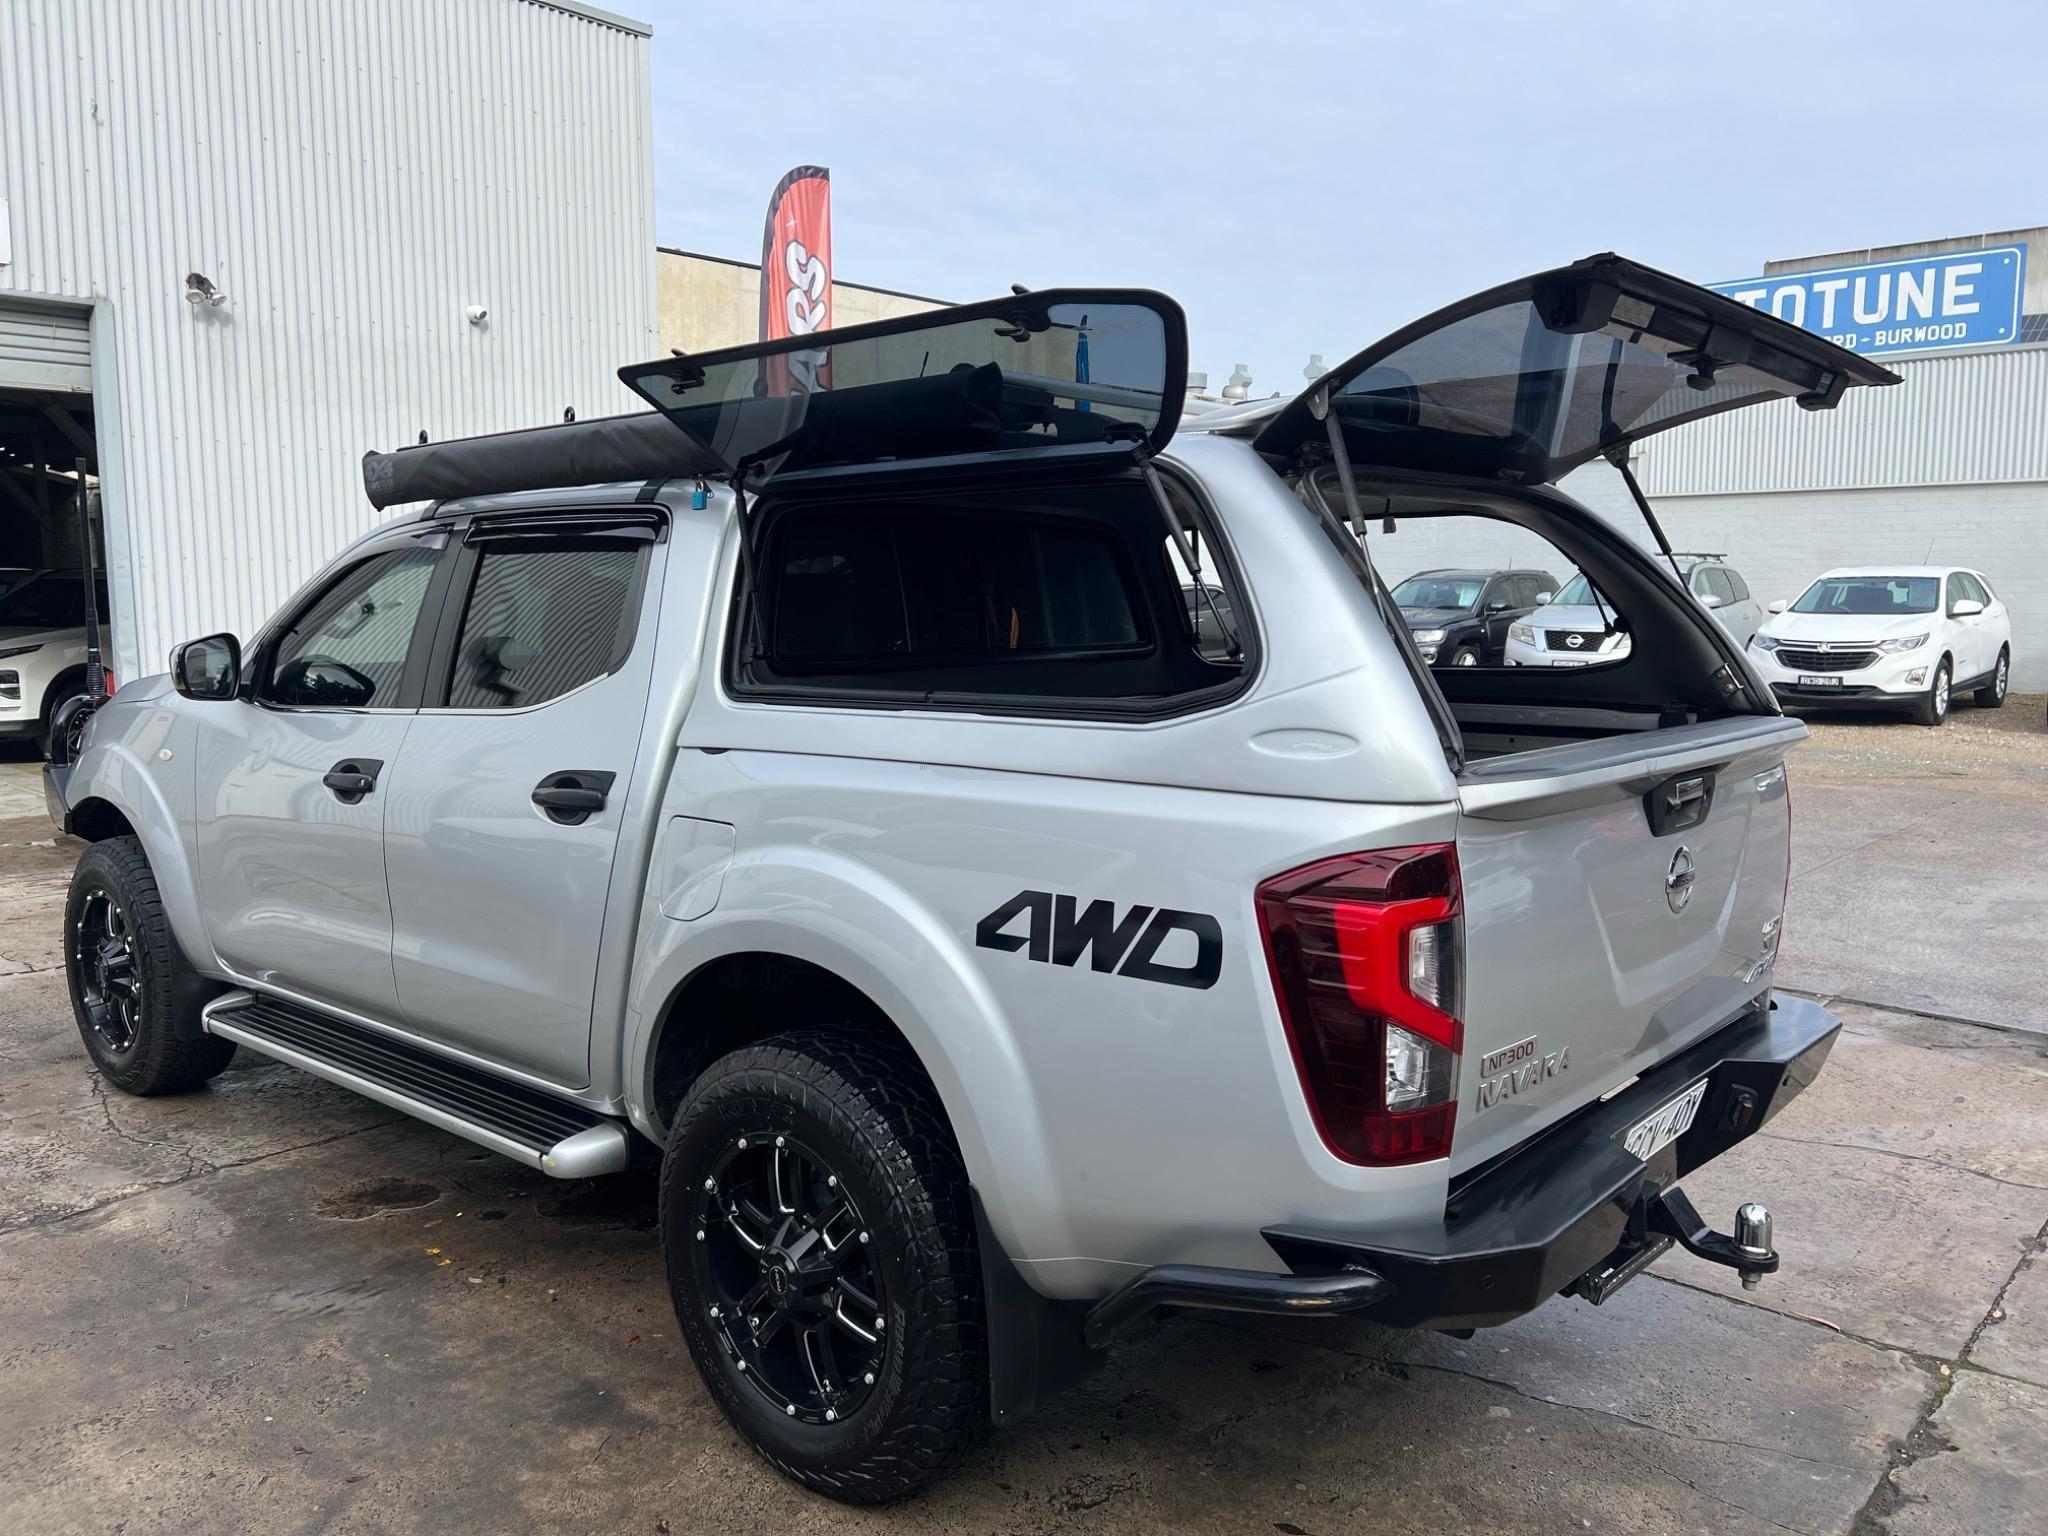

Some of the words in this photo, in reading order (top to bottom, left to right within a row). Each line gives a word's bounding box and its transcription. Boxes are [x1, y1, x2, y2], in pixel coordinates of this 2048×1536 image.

[786, 239, 828, 396] ARS
[1722, 263, 1983, 329] TOTUNE
[1875, 322, 1967, 347] BURWOOD
[975, 889, 1223, 990] 4WD
[1476, 1046, 1570, 1113] NAVARA
[1488, 1041, 1535, 1072] NP300
